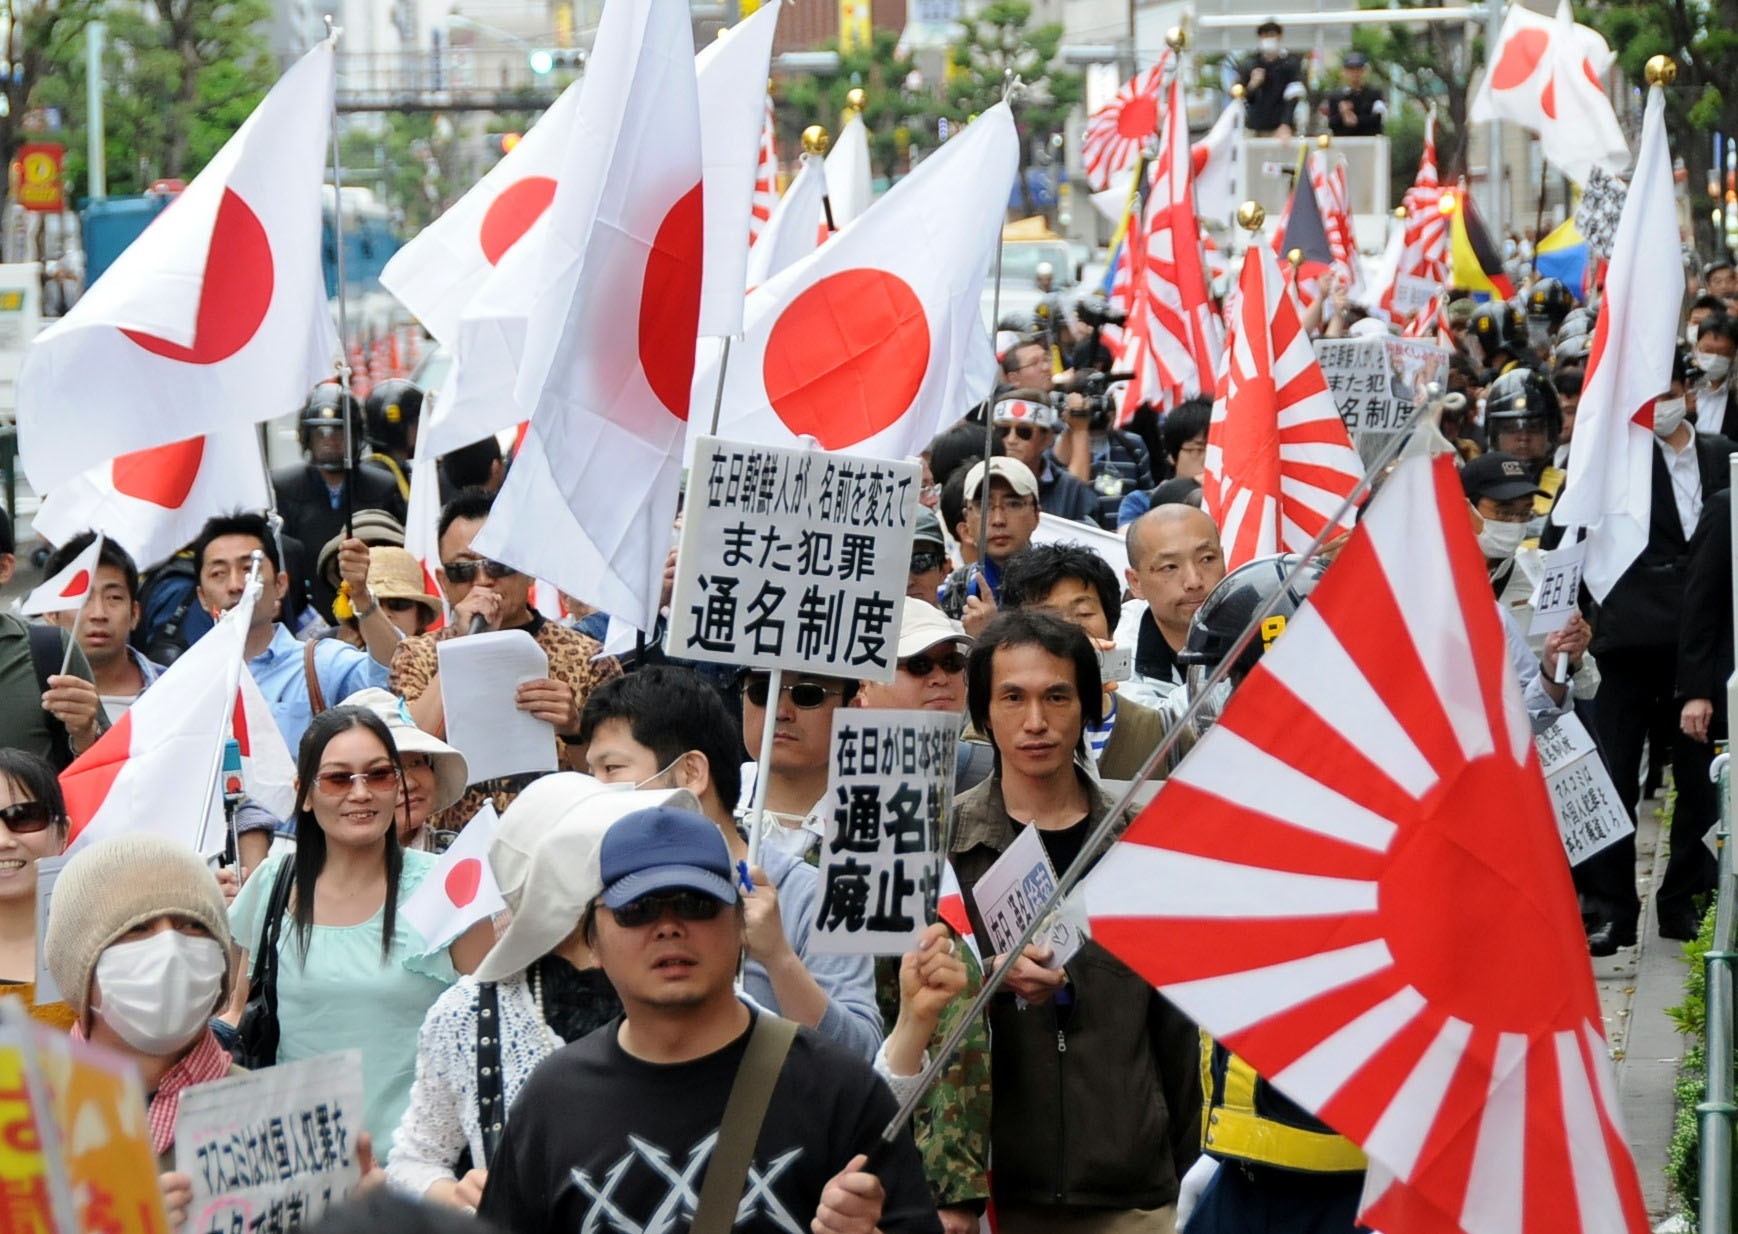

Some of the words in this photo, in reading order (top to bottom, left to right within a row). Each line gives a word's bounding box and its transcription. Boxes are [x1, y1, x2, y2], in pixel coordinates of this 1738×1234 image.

[708, 446, 912, 528] 在日朝鮮人が、名前を変えて
[723, 521, 876, 582] また犯罪
[687, 574, 895, 669] 通名制度
[196, 1099, 350, 1195] マスコミは外国人犯罪を
